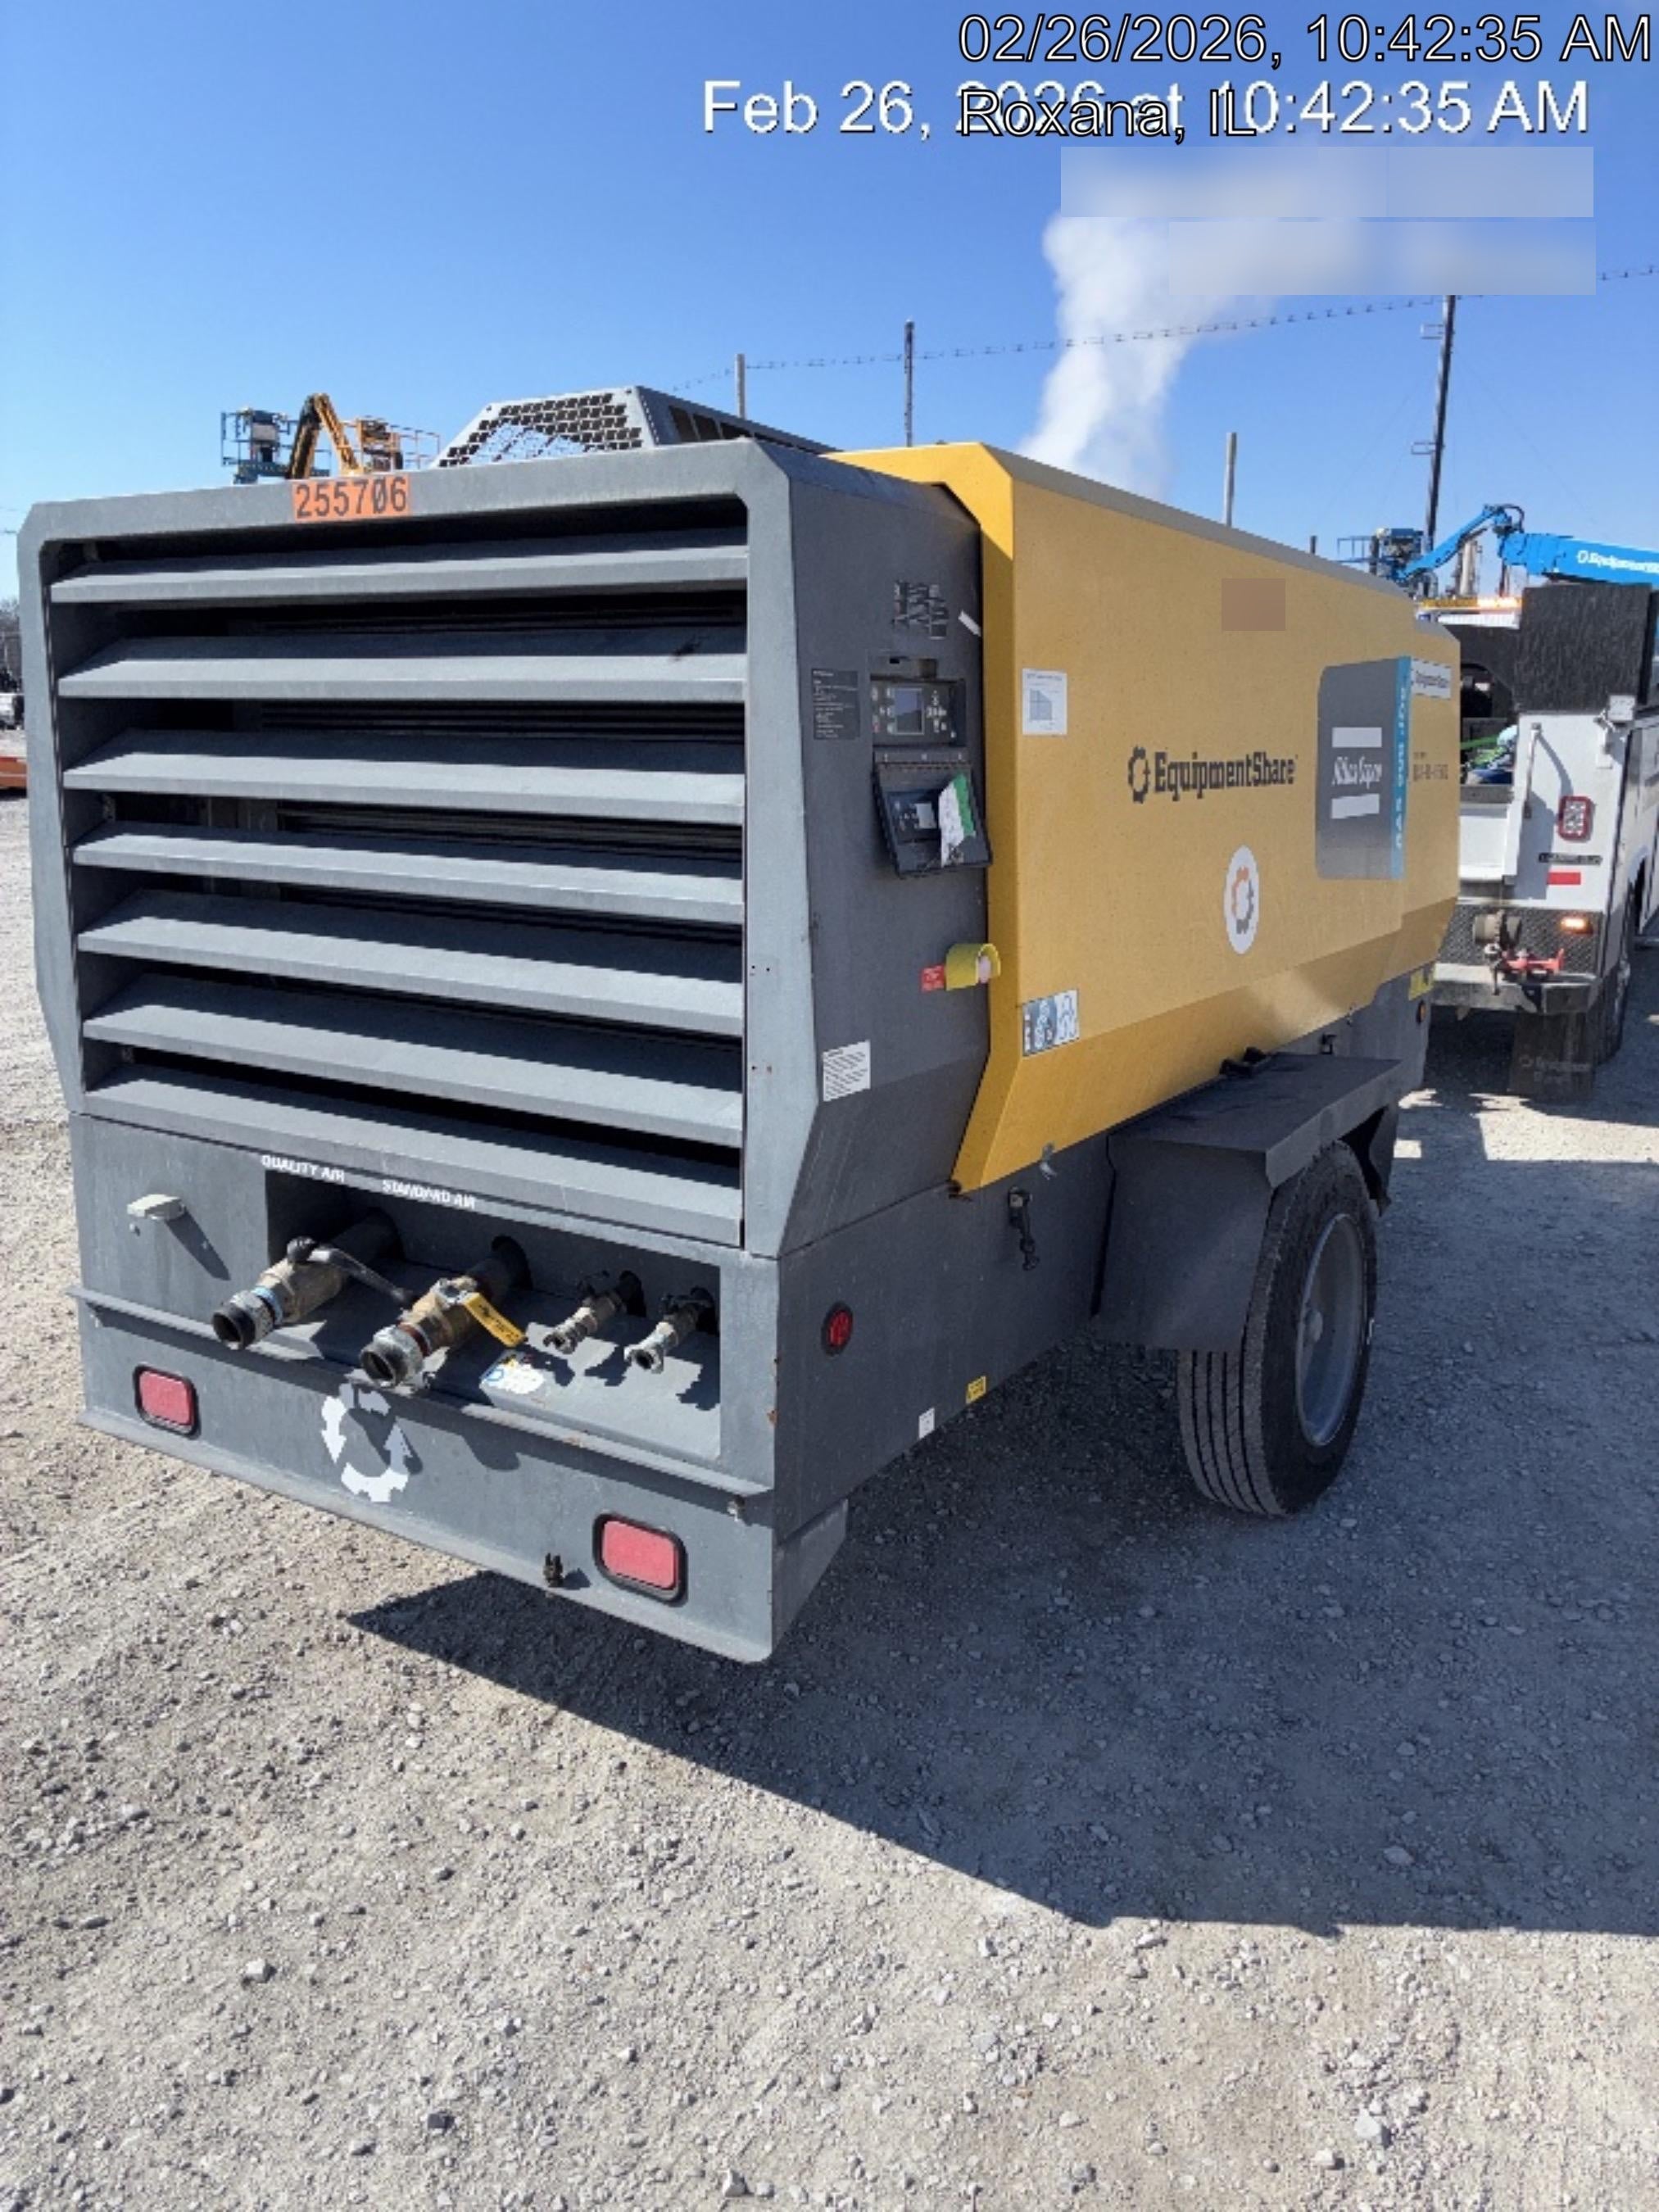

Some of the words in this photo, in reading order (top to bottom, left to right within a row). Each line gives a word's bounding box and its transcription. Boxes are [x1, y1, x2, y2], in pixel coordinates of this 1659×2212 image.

[296, 476, 407, 519] 255706
[1154, 750, 1296, 802] EquipmentShare
[261, 1154, 320, 1176] QUALITY
[382, 1179, 451, 1203] STANDARD
